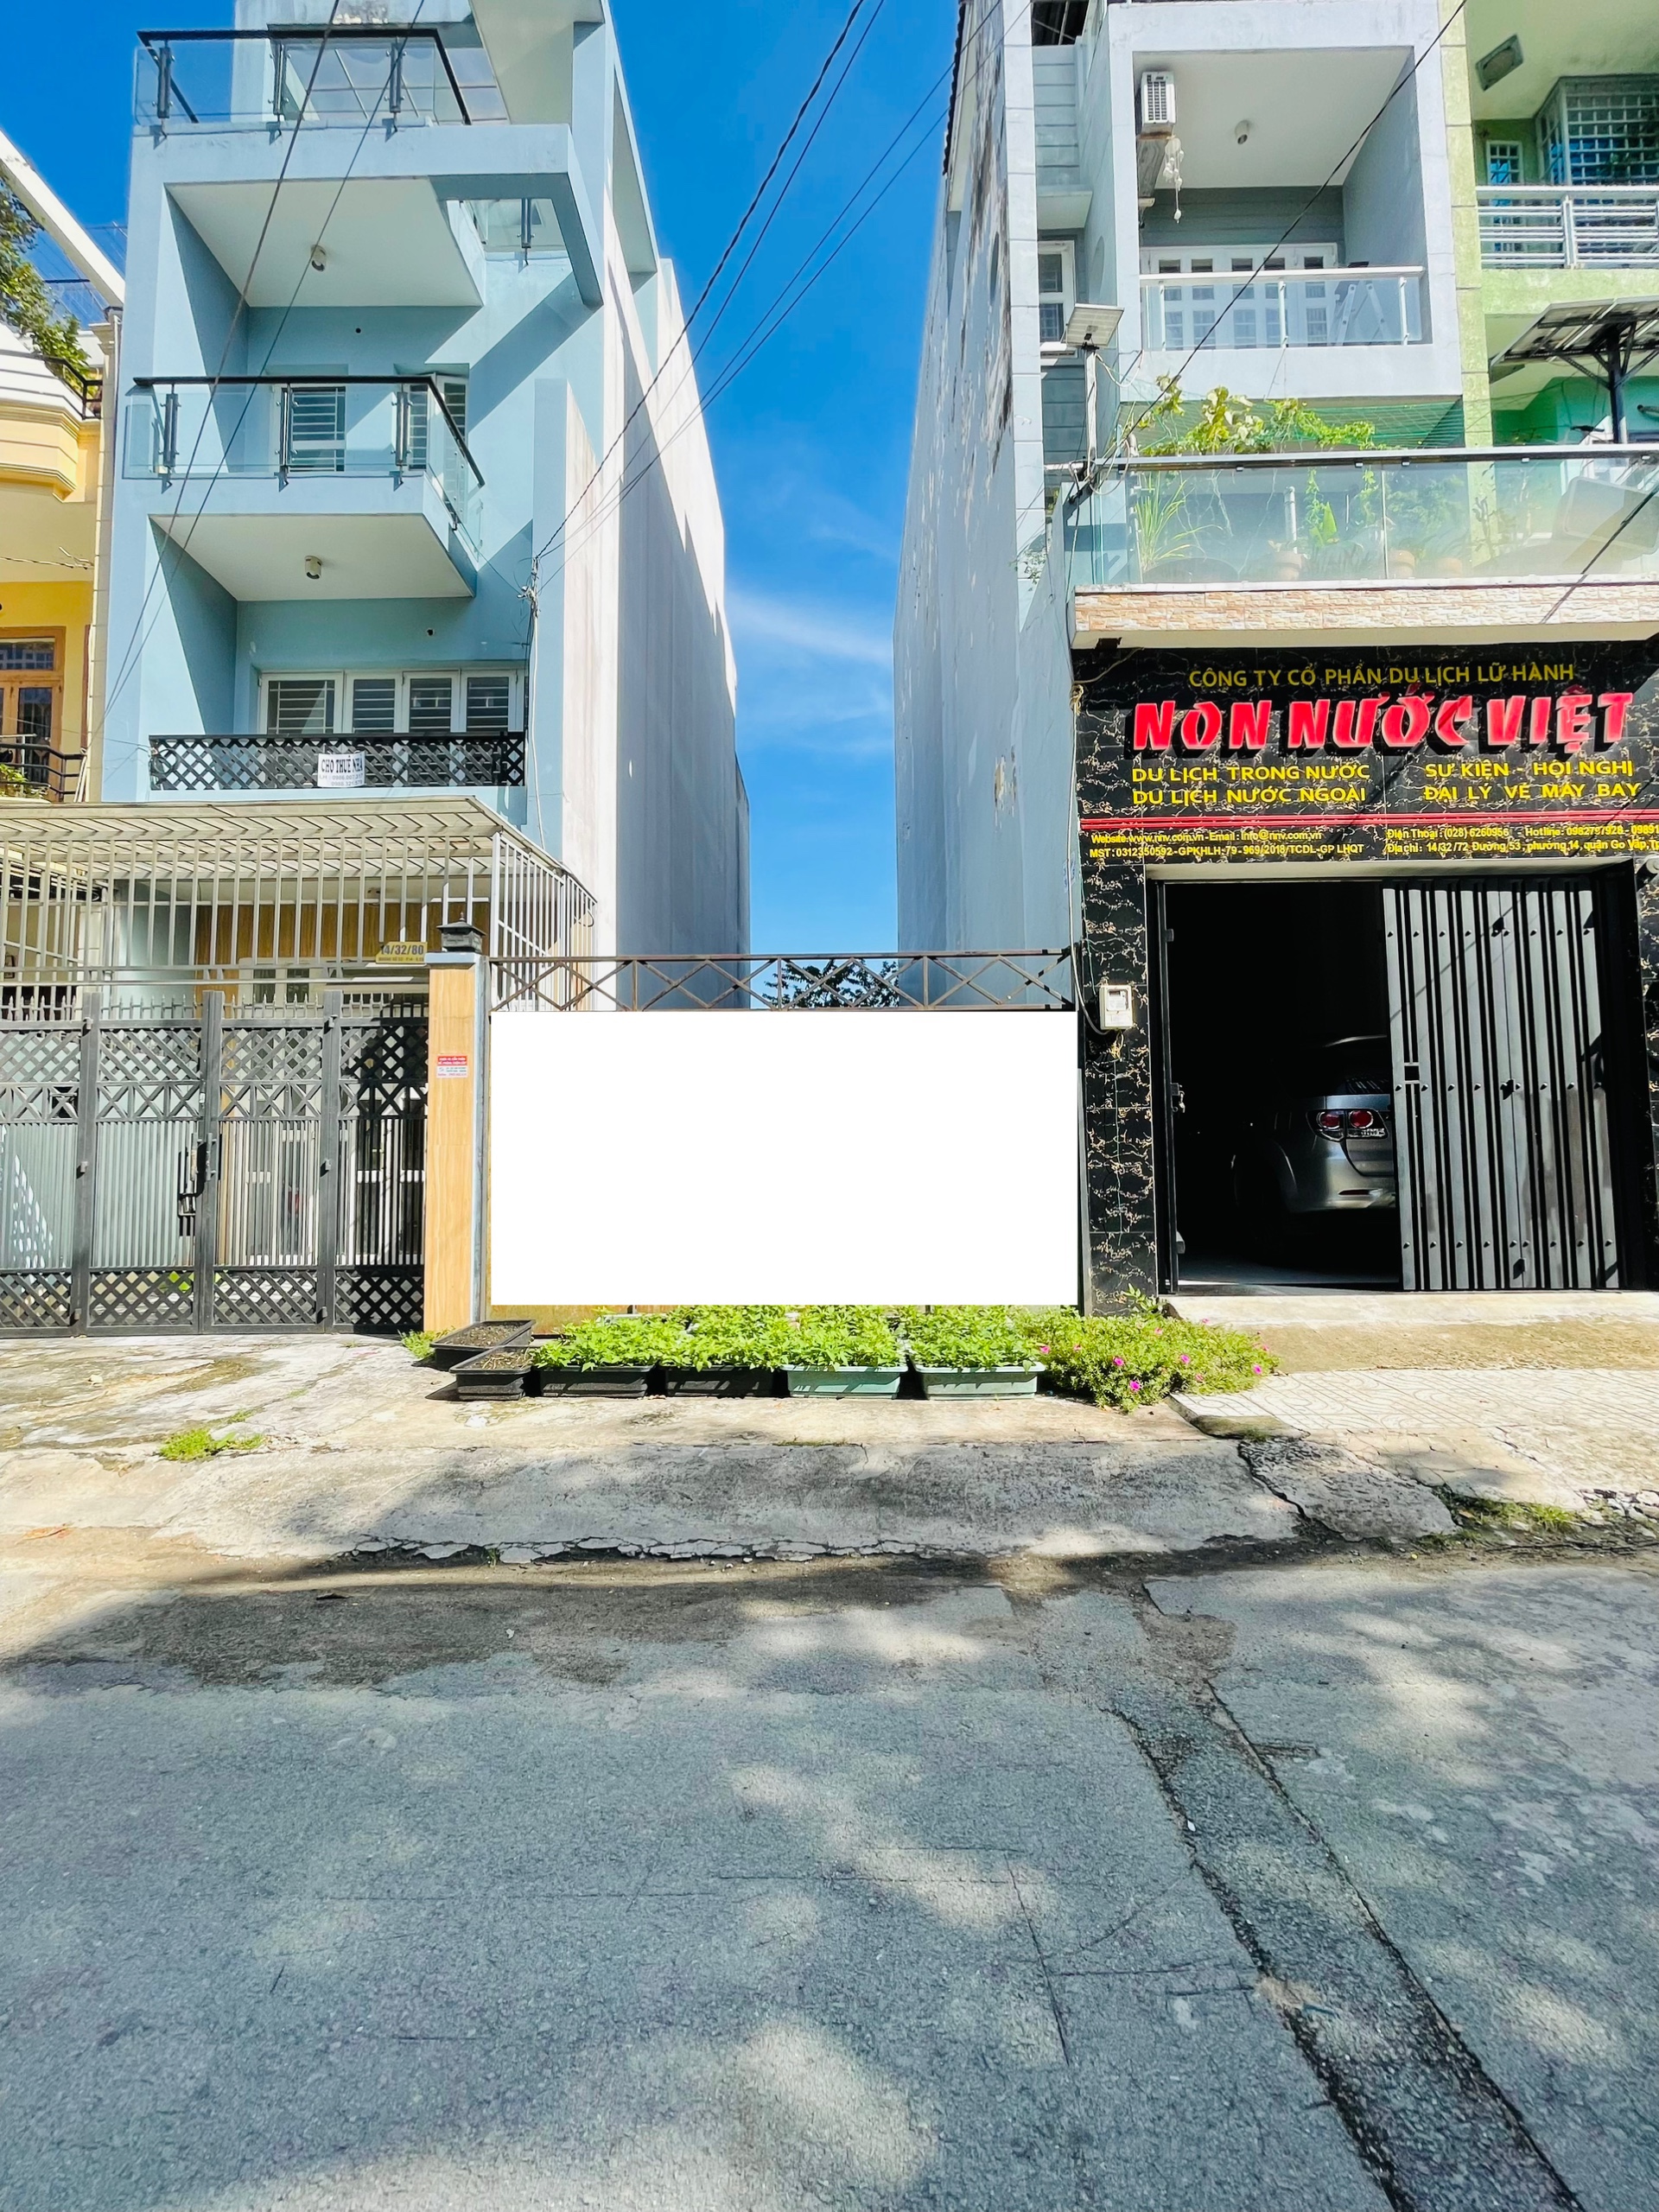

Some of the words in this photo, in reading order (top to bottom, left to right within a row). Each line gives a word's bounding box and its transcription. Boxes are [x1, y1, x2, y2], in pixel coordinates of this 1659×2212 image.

[1189, 668, 1247, 687] CÔNG
[1254, 670, 1281, 686] TY
[1287, 663, 1316, 685] CỔ
[1389, 667, 1419, 683] DU
[1426, 666, 1469, 686] LỊCH
[1478, 663, 1506, 683] LỮ
[1512, 662, 1574, 681] HÀNH
[1134, 700, 1273, 750] NON
[1287, 683, 1473, 749] NƯỚC
[1486, 684, 1633, 753] VIỆT
[321, 759, 334, 773] CHO
[335, 754, 352, 773] THUÊ
[1133, 767, 1163, 782] DU
[1170, 766, 1217, 784] LỊCH
[1227, 766, 1300, 779] TRONG
[1306, 762, 1370, 779] NƯỚC
[1461, 760, 1510, 779] KIỆN
[1533, 760, 1572, 779] HỘI
[1579, 760, 1634, 777] NGHỊ
[1133, 790, 1163, 804] DU
[1171, 790, 1217, 806] LỊCH
[1227, 785, 1292, 803] NƯỚC
[1300, 784, 1365, 802] NGOÀI
[1423, 785, 1458, 802] ĐẠI
[1468, 783, 1492, 800] LÝ
[1598, 782, 1641, 798] BAY
[1444, 828, 1467, 841] (028)
[1469, 827, 1510, 837] 6260956
[1337, 844, 1364, 854] LHQT
